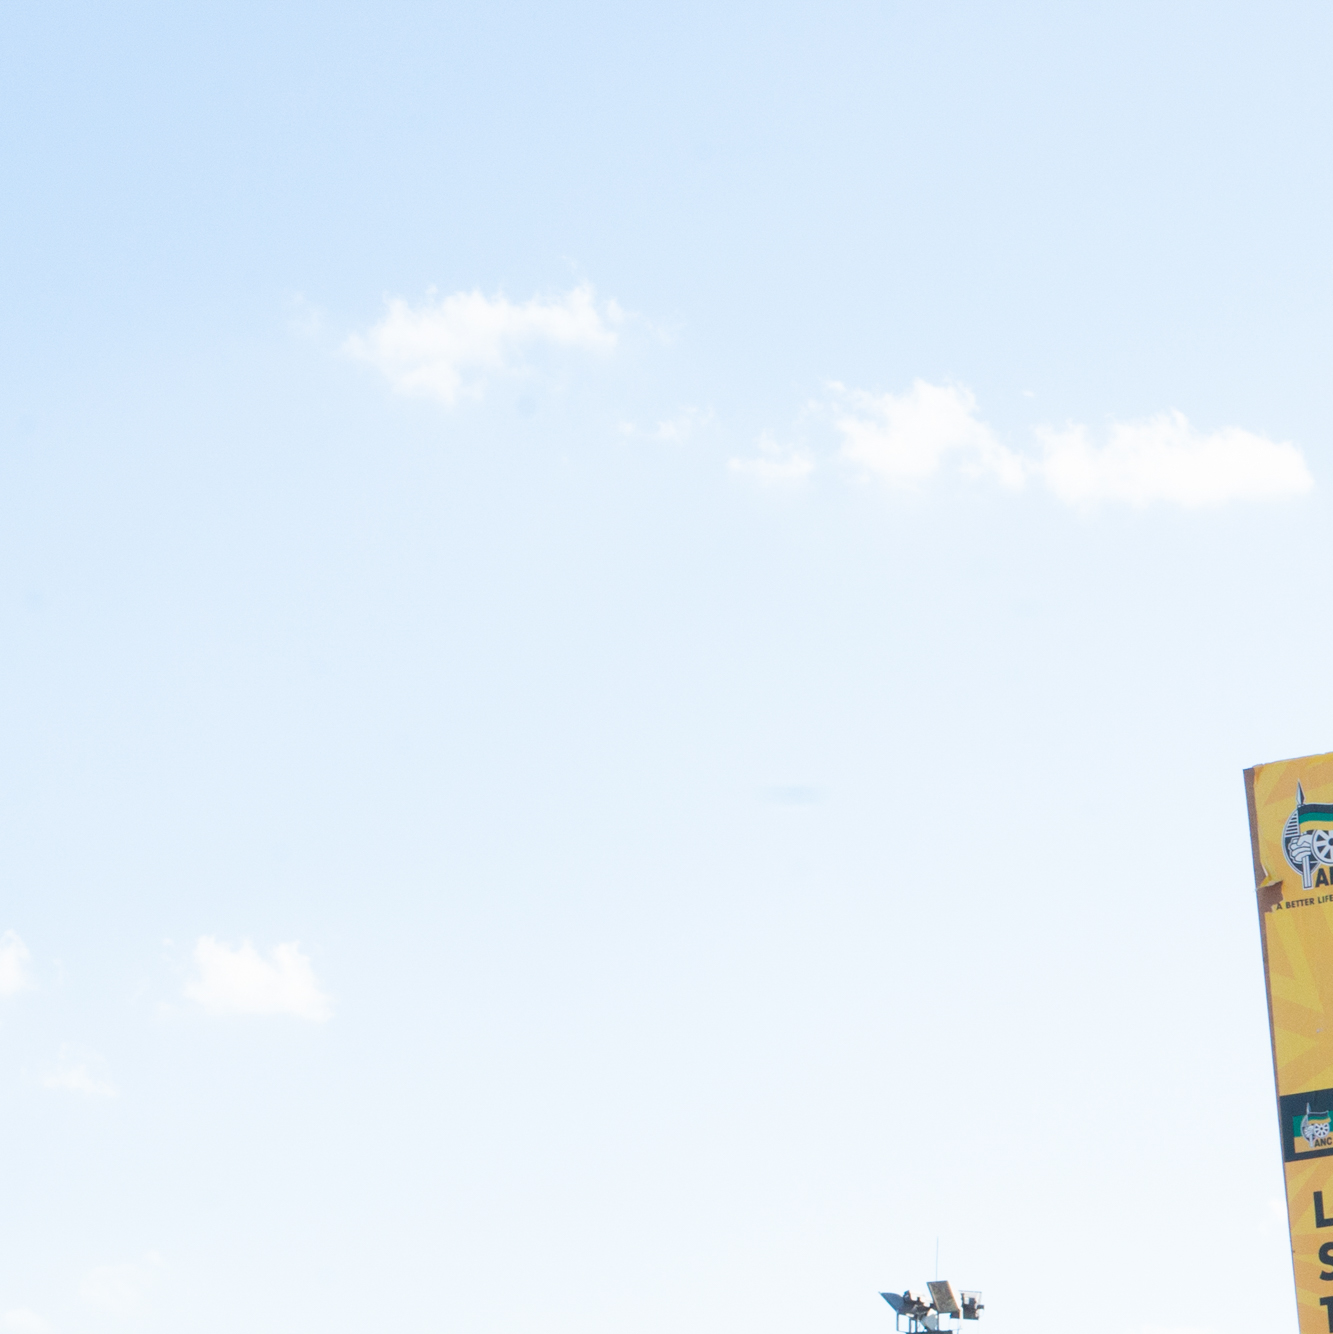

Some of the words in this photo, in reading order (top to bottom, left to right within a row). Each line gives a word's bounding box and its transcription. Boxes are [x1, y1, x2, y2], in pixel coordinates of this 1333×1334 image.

[1276, 902, 1283, 910] A
[1285, 898, 1315, 909] BETTER
[1317, 894, 1333, 904] LIFE
[1314, 1137, 1333, 1147] ANC
